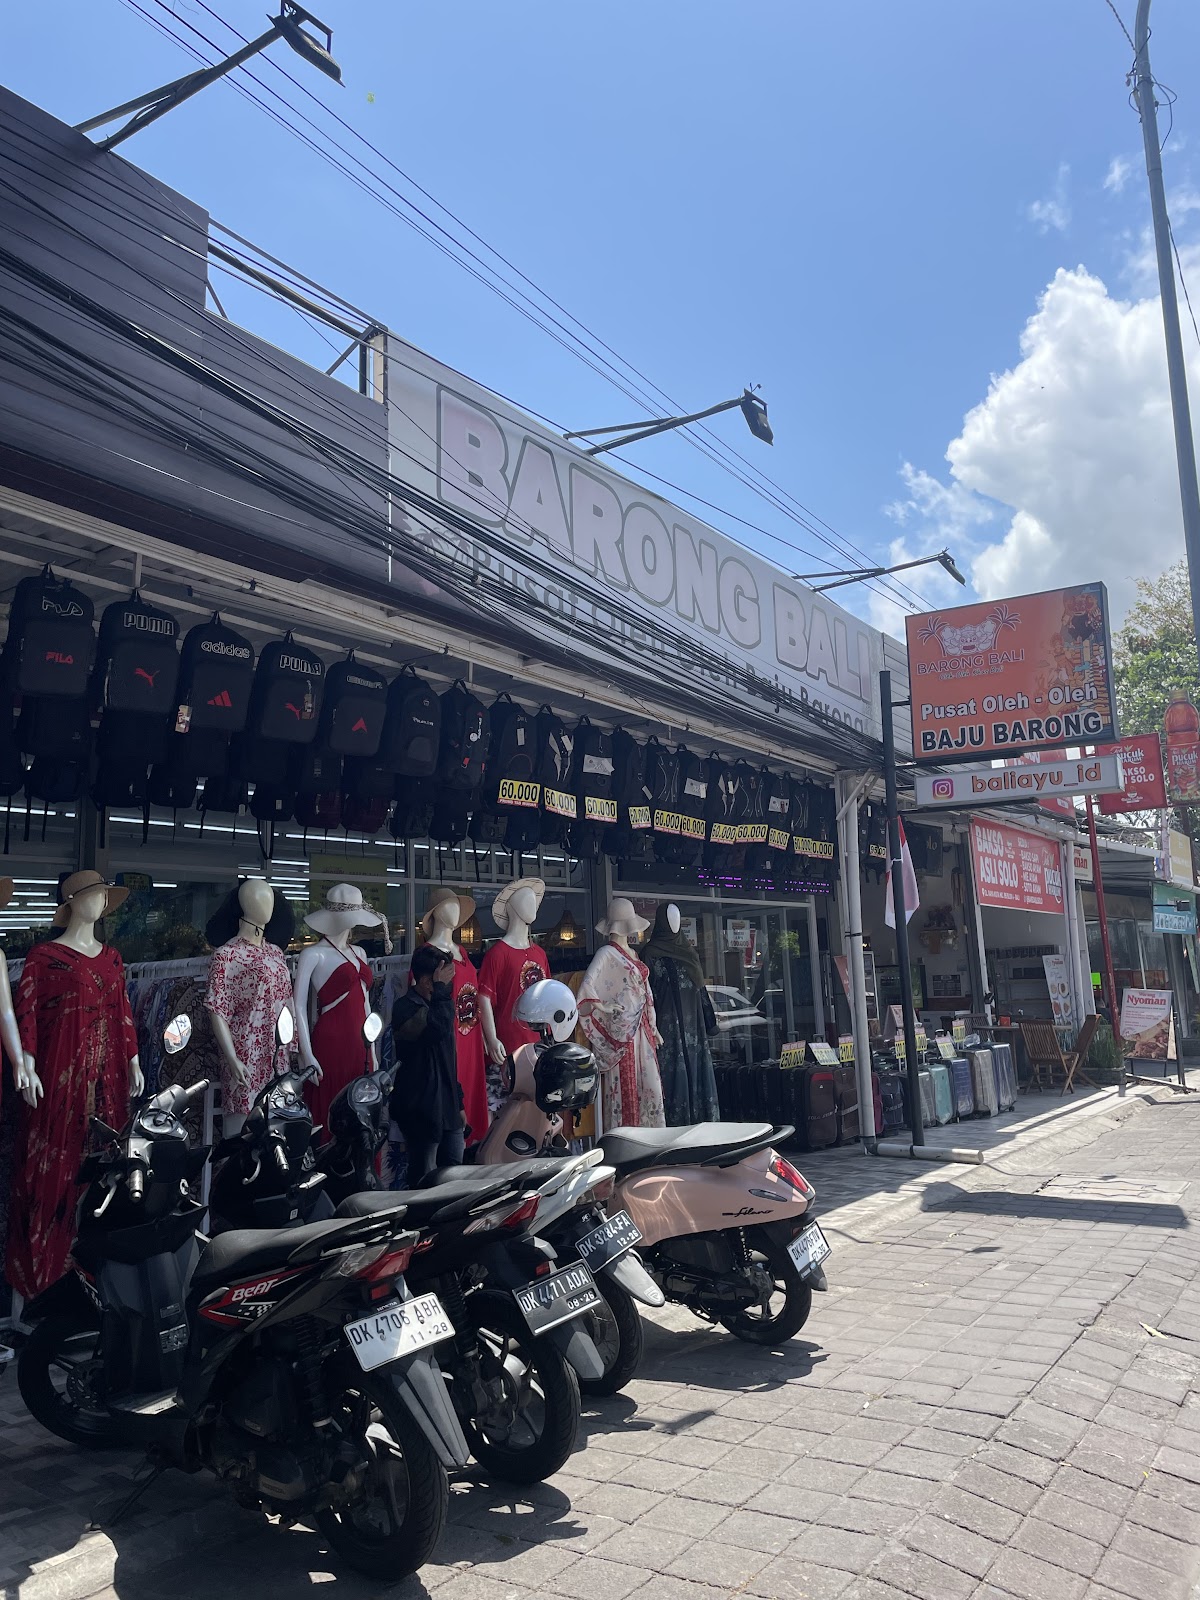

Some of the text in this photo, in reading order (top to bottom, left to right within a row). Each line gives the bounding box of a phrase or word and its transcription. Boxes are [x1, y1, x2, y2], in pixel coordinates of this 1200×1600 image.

[436, 384, 871, 704] BARONG BALI
[123, 612, 174, 635] PUMA
[46, 651, 74, 664] FILA
[201, 640, 250, 659] adidas
[280, 654, 321, 676] PUMA
[917, 648, 1025, 675] BARONG BALI
[921, 699, 977, 721] Pusat
[982, 692, 1029, 713] Oleh
[1048, 683, 1098, 706] Oleh
[922, 710, 1103, 752] BAJU BARONG
[1117, 748, 1144, 759] ucuk
[972, 763, 1102, 793] baliayu_id
[1123, 766, 1146, 776] AKSO
[1131, 773, 1155, 784] SOLO
[501, 781, 538, 801] 60.000
[545, 790, 575, 812] 60.000
[586, 799, 616, 817] 60.000
[655, 811, 680, 830] 60.000
[682, 817, 705, 834] 60.000
[711, 824, 736, 840] 60.000
[737, 825, 767, 839] 60.000
[975, 825, 1004, 857] BAKSO
[812, 842, 832, 855] 0.000
[980, 856, 1019, 888] ASLI SOLO
[1127, 995, 1167, 1005] Nyoman
[578, 1214, 631, 1258] DK 3284 FA
[791, 1245, 803, 1260] DK
[520, 1269, 589, 1313] DK 4471 ADA
[376, 1301, 397, 1312] HONDA
[349, 1298, 441, 1346] DK 4706 ABH
